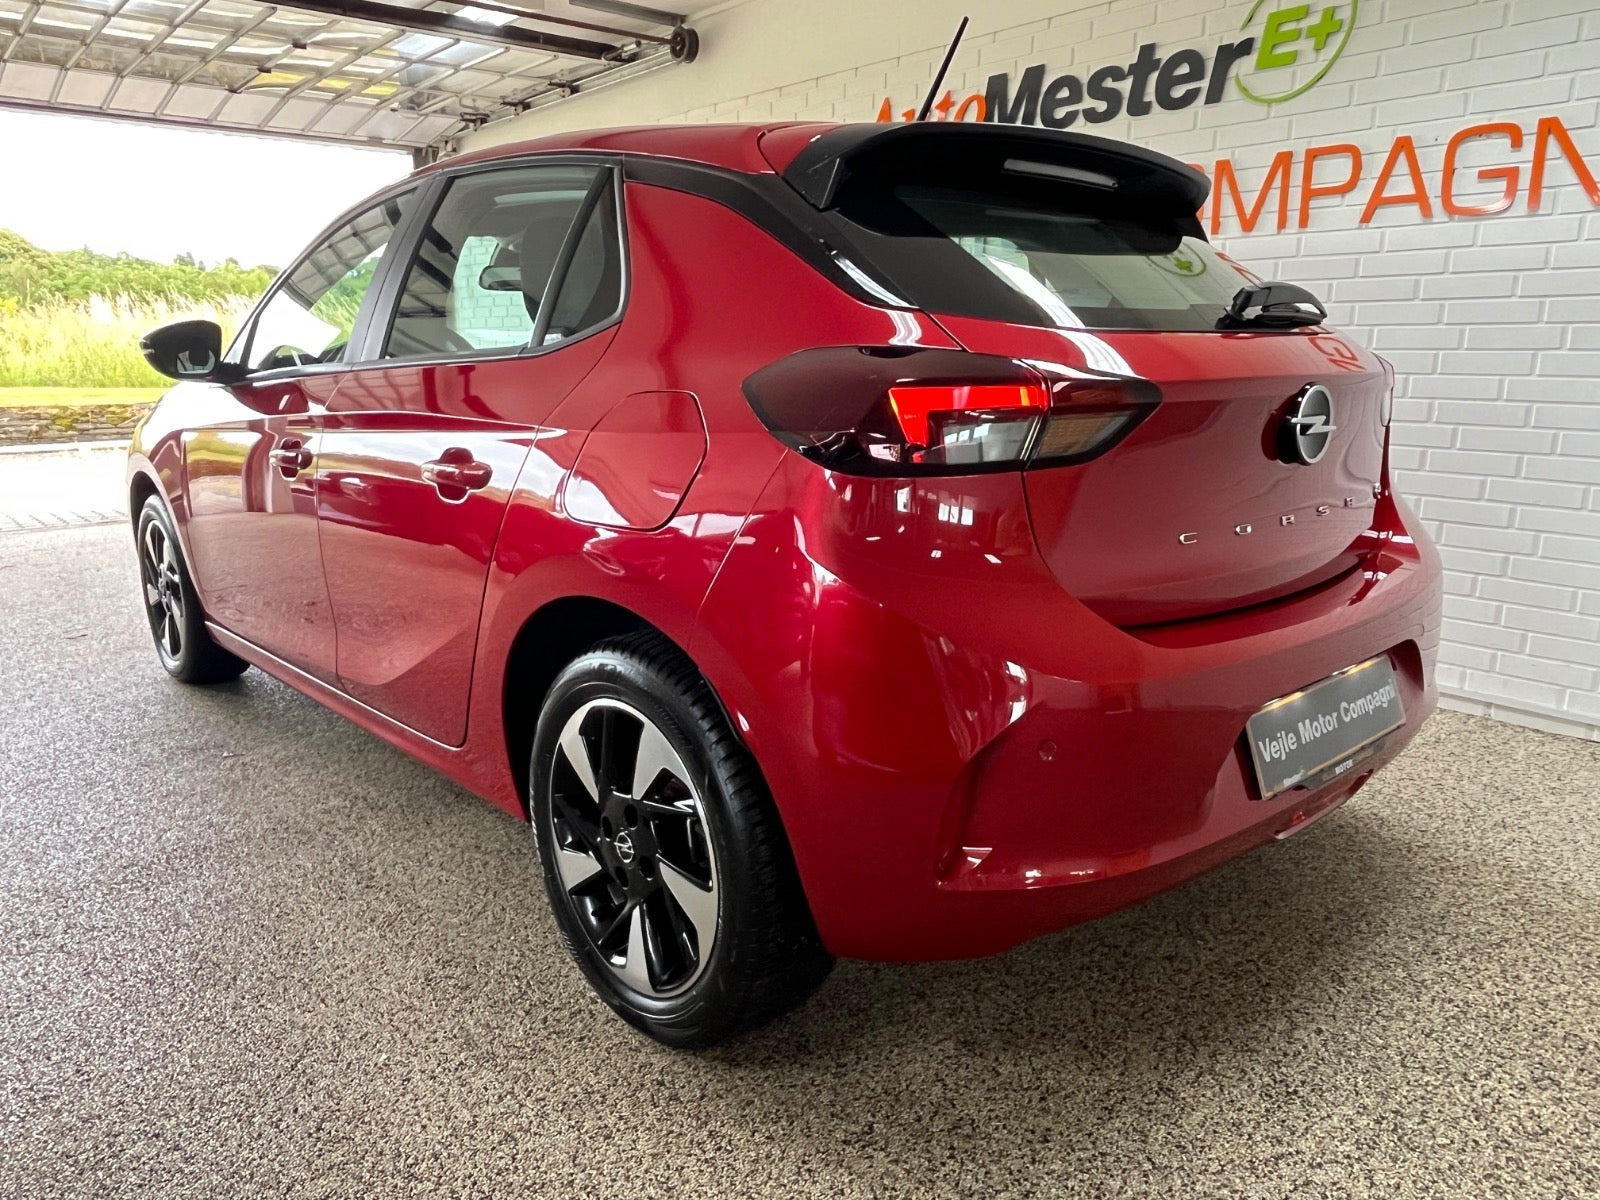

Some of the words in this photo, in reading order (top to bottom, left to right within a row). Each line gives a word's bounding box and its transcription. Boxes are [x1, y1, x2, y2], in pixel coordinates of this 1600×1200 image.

[1197, 116, 1600, 236] MPAGN
[1258, 731, 1298, 763] Vejle
[1298, 711, 1338, 745] Motor
[1340, 678, 1396, 723] Compagni
